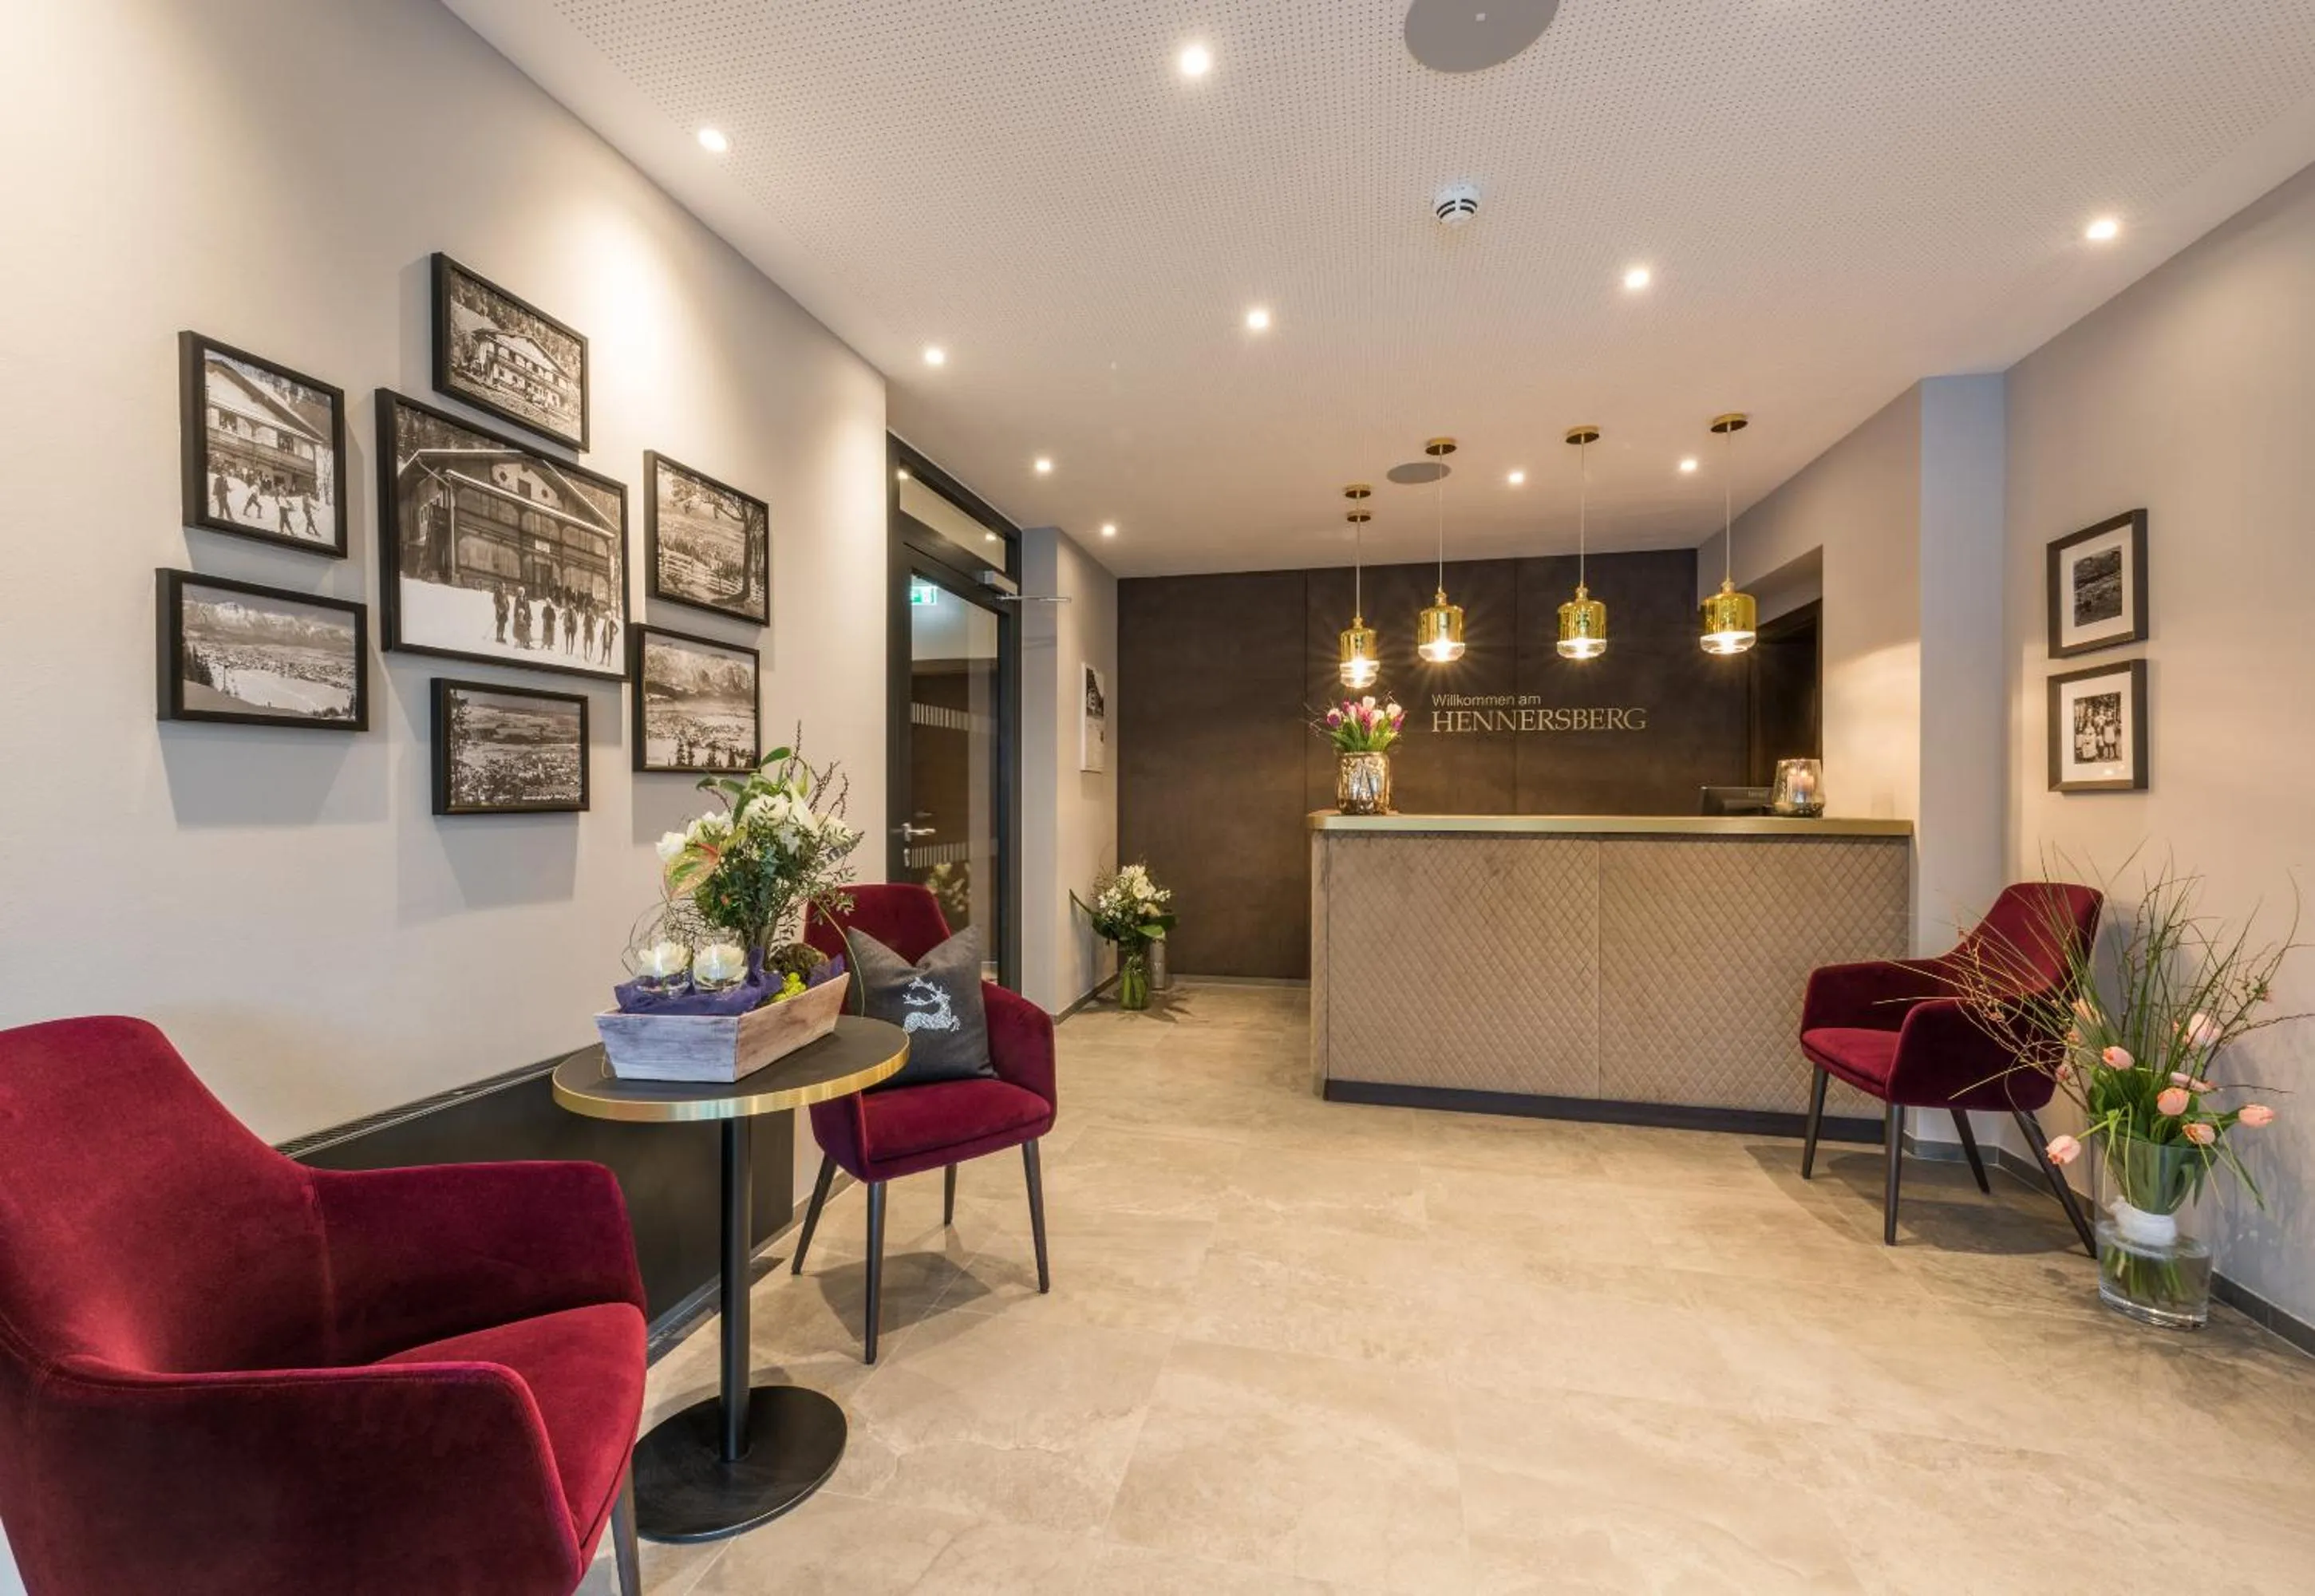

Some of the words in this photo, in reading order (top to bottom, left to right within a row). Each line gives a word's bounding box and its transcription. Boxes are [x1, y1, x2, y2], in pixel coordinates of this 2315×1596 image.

[1432, 693, 1515, 706] Willkommen
[1519, 695, 1541, 705] am
[1432, 708, 1647, 733] HENNERSBERG
